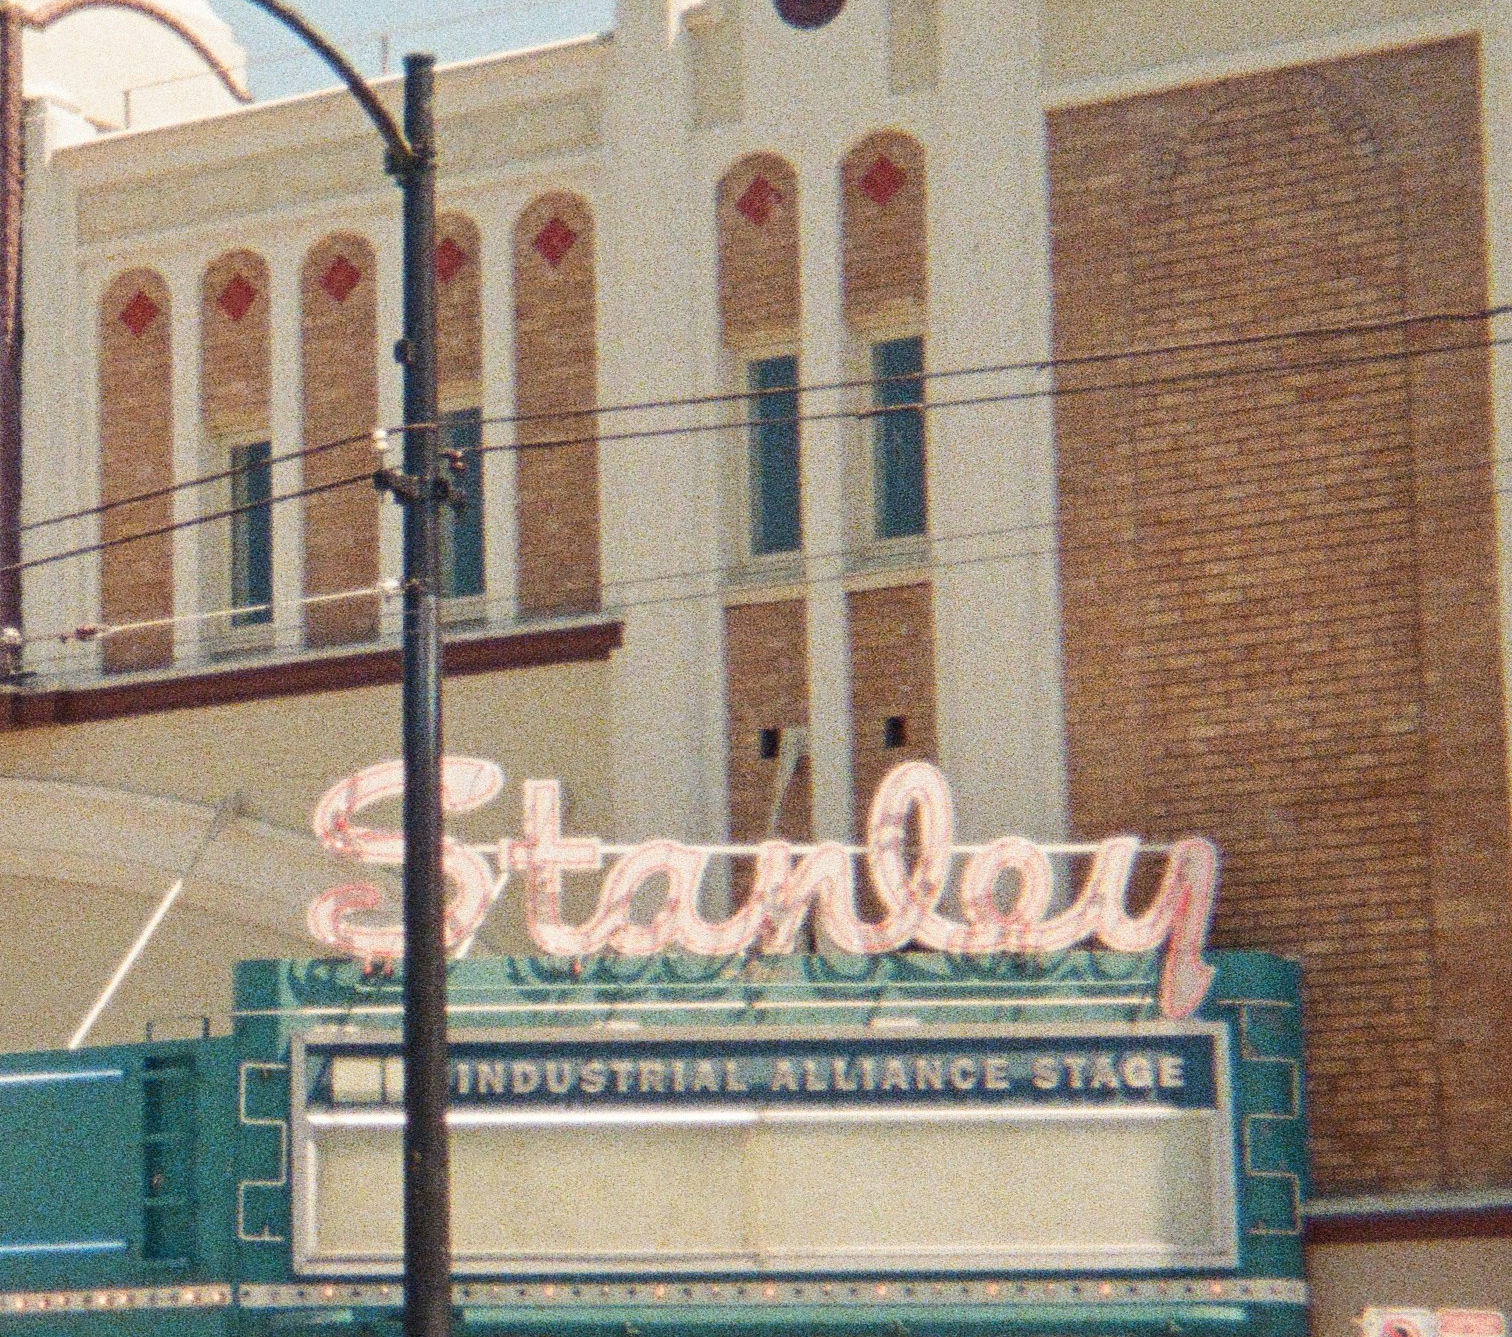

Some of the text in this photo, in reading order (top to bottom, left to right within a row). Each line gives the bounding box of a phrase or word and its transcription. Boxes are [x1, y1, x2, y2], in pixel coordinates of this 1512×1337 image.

[307, 755, 1219, 1020] Stanley
[456, 1054, 1186, 1095] INDUSTRIAL ALLIANCE STAGE
